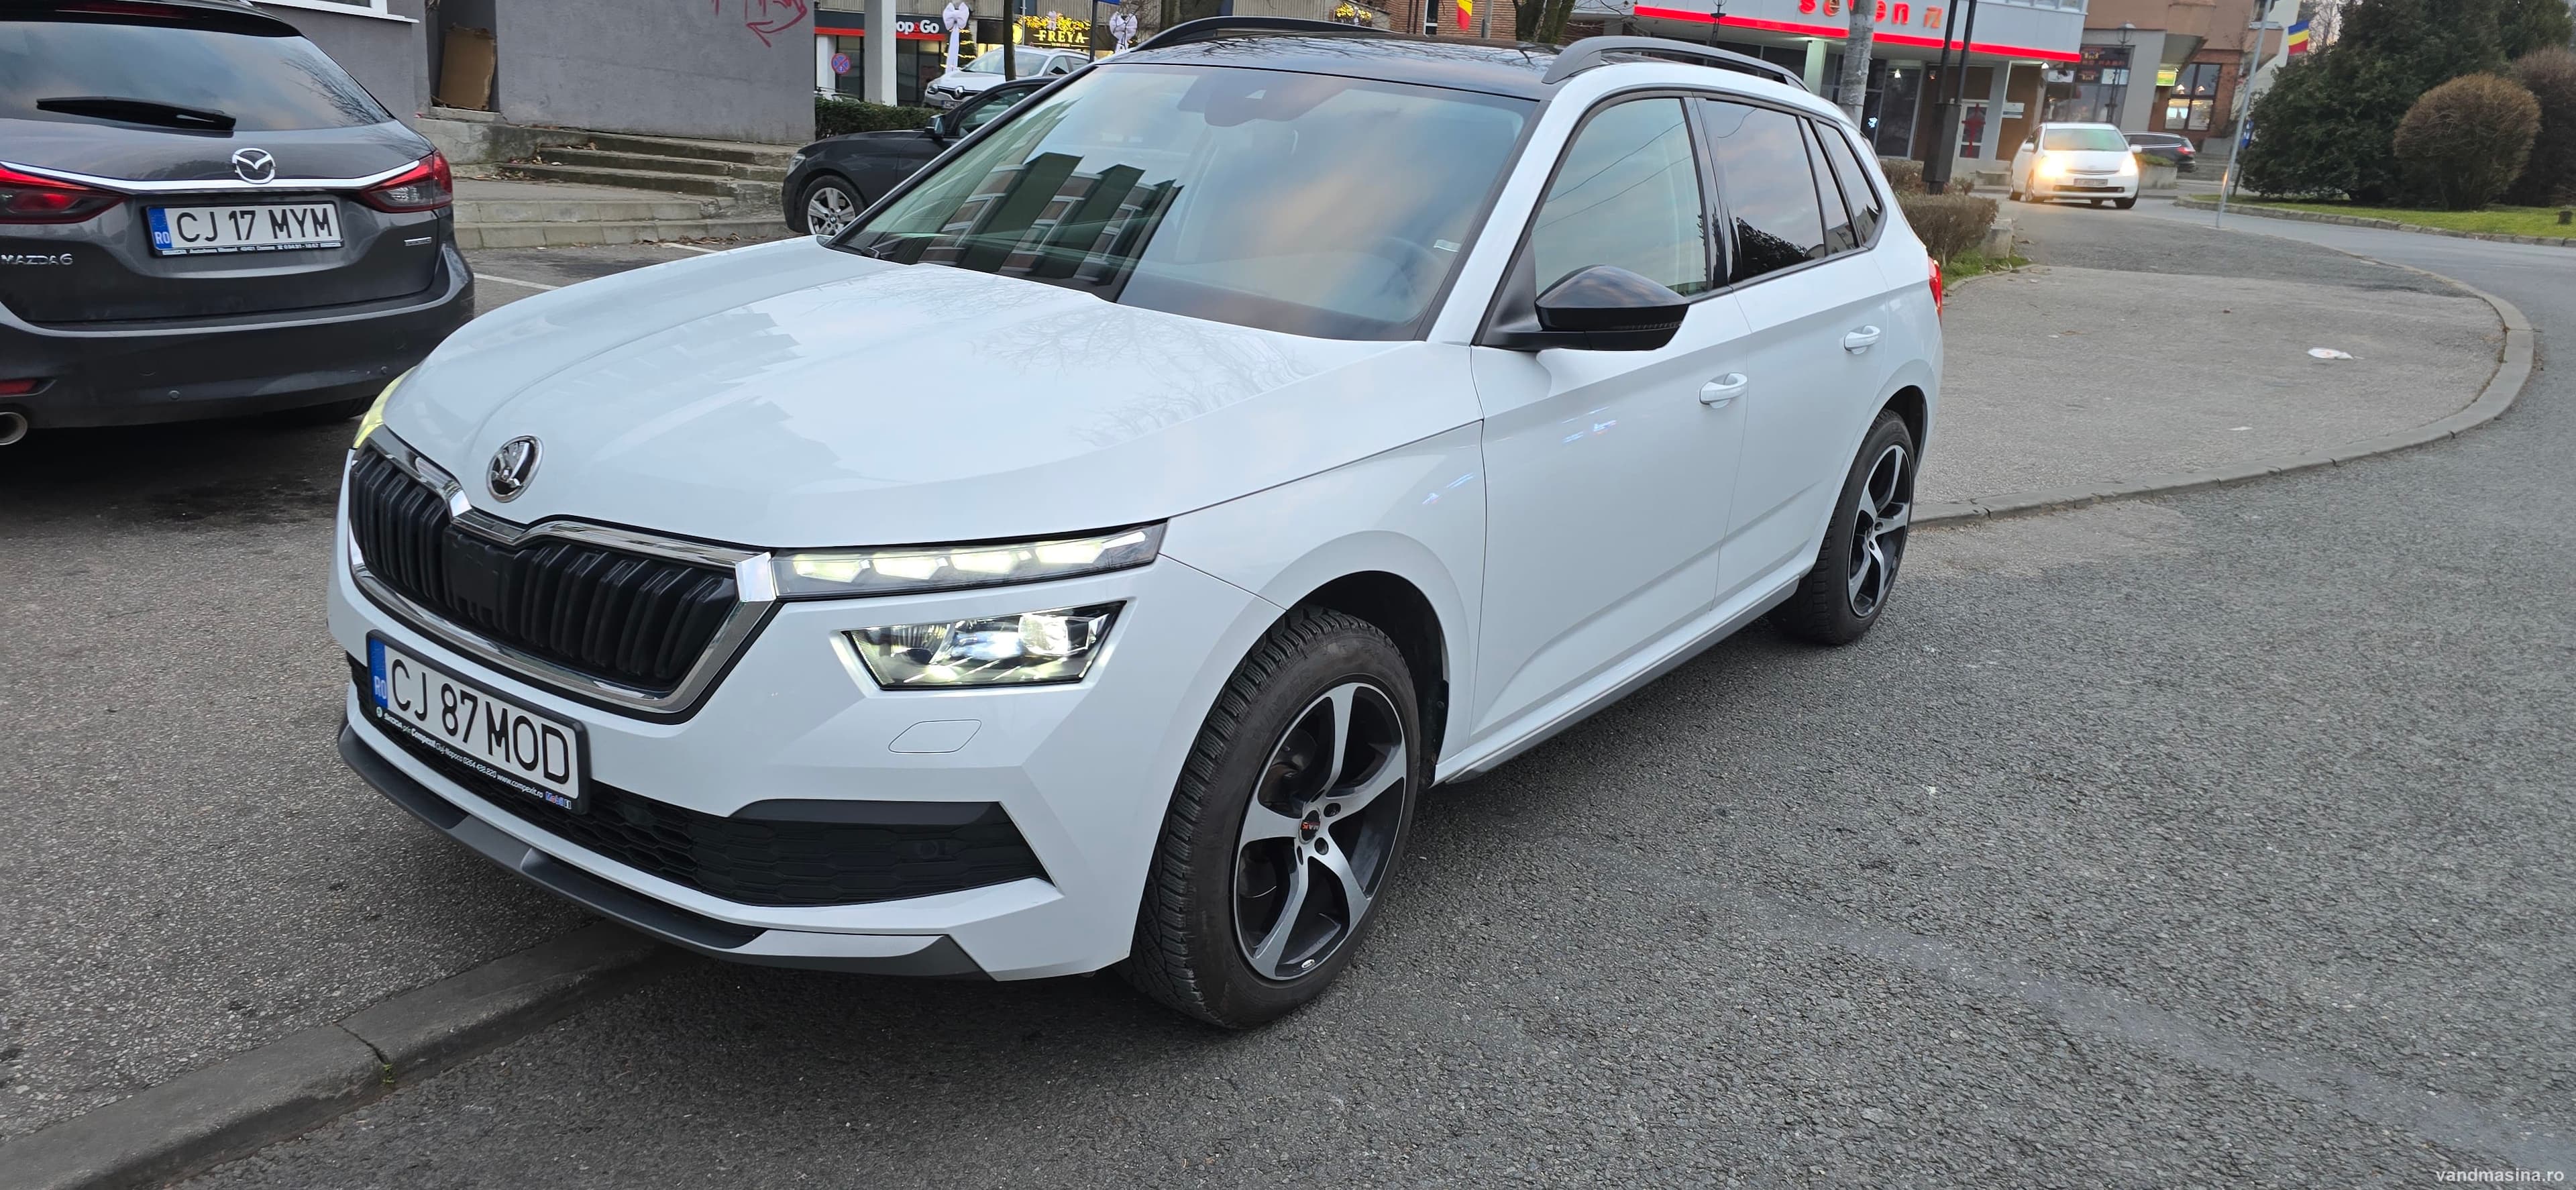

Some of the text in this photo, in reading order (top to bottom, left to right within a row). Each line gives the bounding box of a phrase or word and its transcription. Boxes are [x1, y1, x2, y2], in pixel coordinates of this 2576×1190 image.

[1799, 0, 1910, 25] seen
[1038, 30, 1085, 44] FREYA
[154, 207, 333, 244] RO CJ 17 MYM
[374, 659, 570, 785] RO CJ 87 MOD
